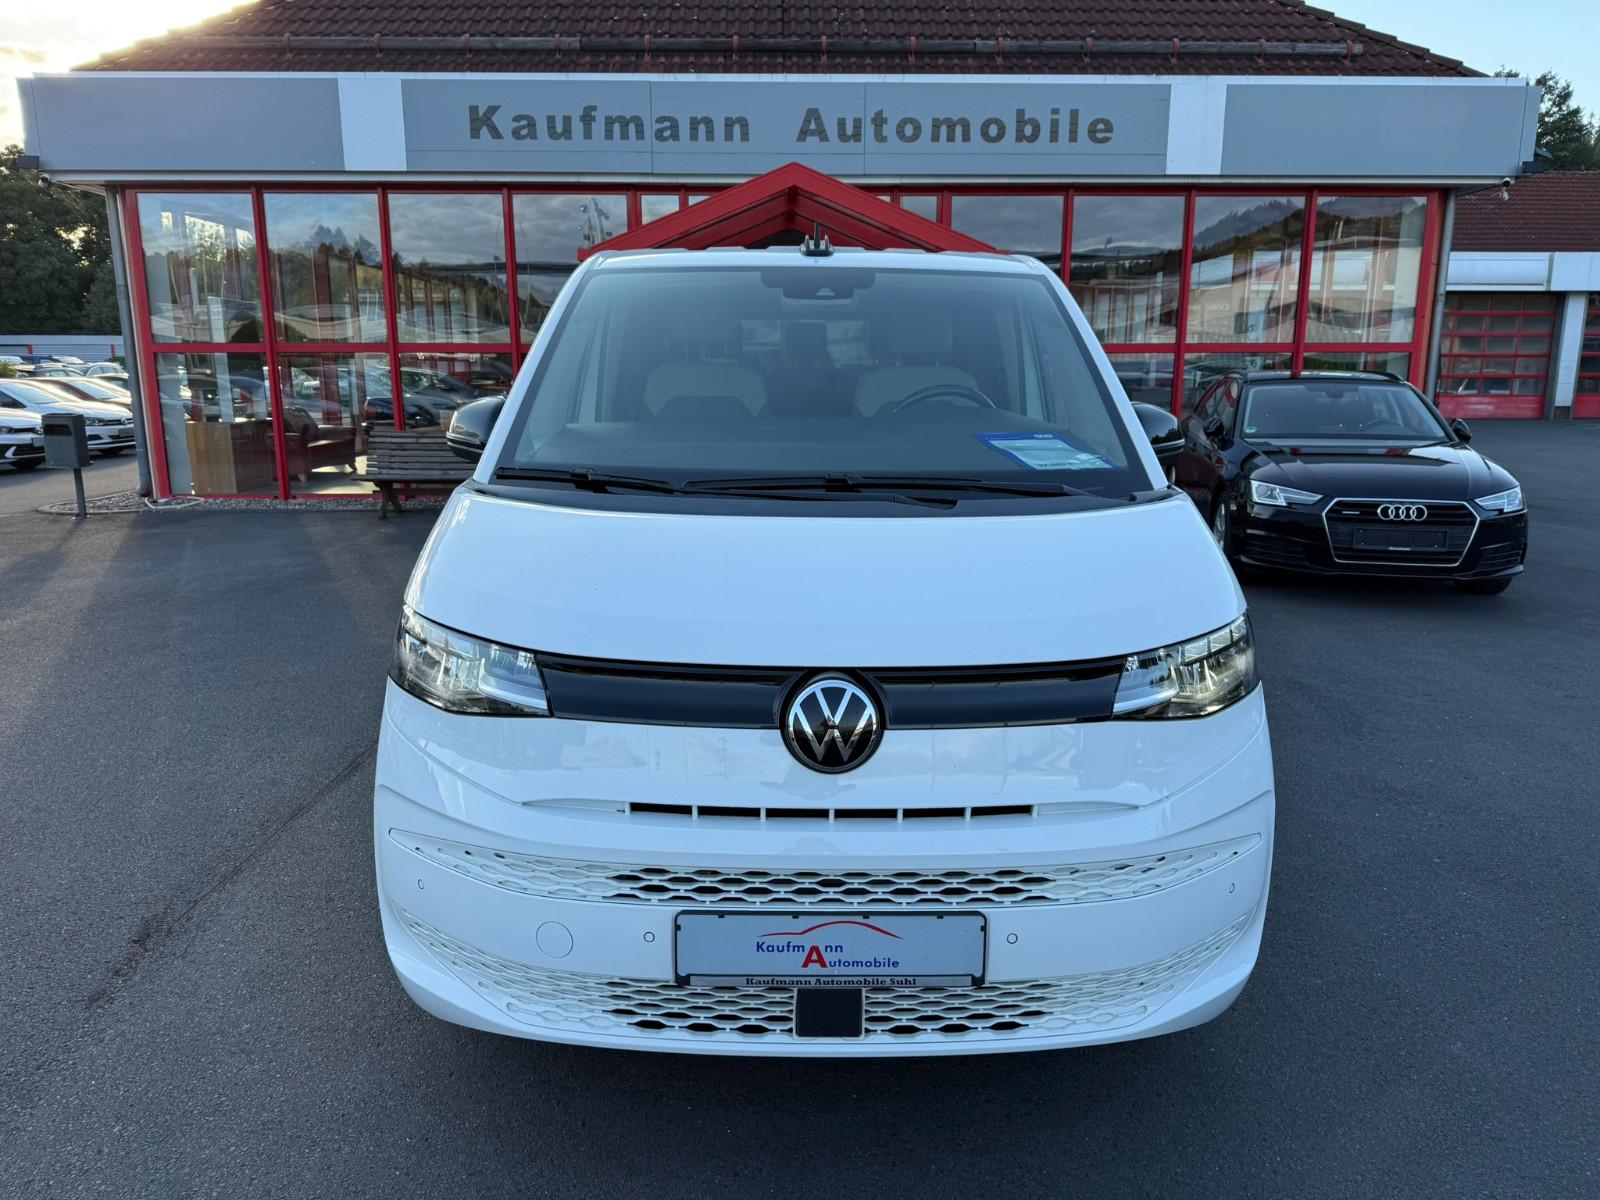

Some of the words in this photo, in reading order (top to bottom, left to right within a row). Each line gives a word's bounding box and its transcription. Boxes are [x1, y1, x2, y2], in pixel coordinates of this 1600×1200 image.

[468, 104, 750, 143] Kaufmann
[796, 107, 1114, 144] Automobile
[745, 976, 811, 987] Kaufmann
[814, 976, 887, 987] Automobile
[889, 976, 917, 987] Suhl
